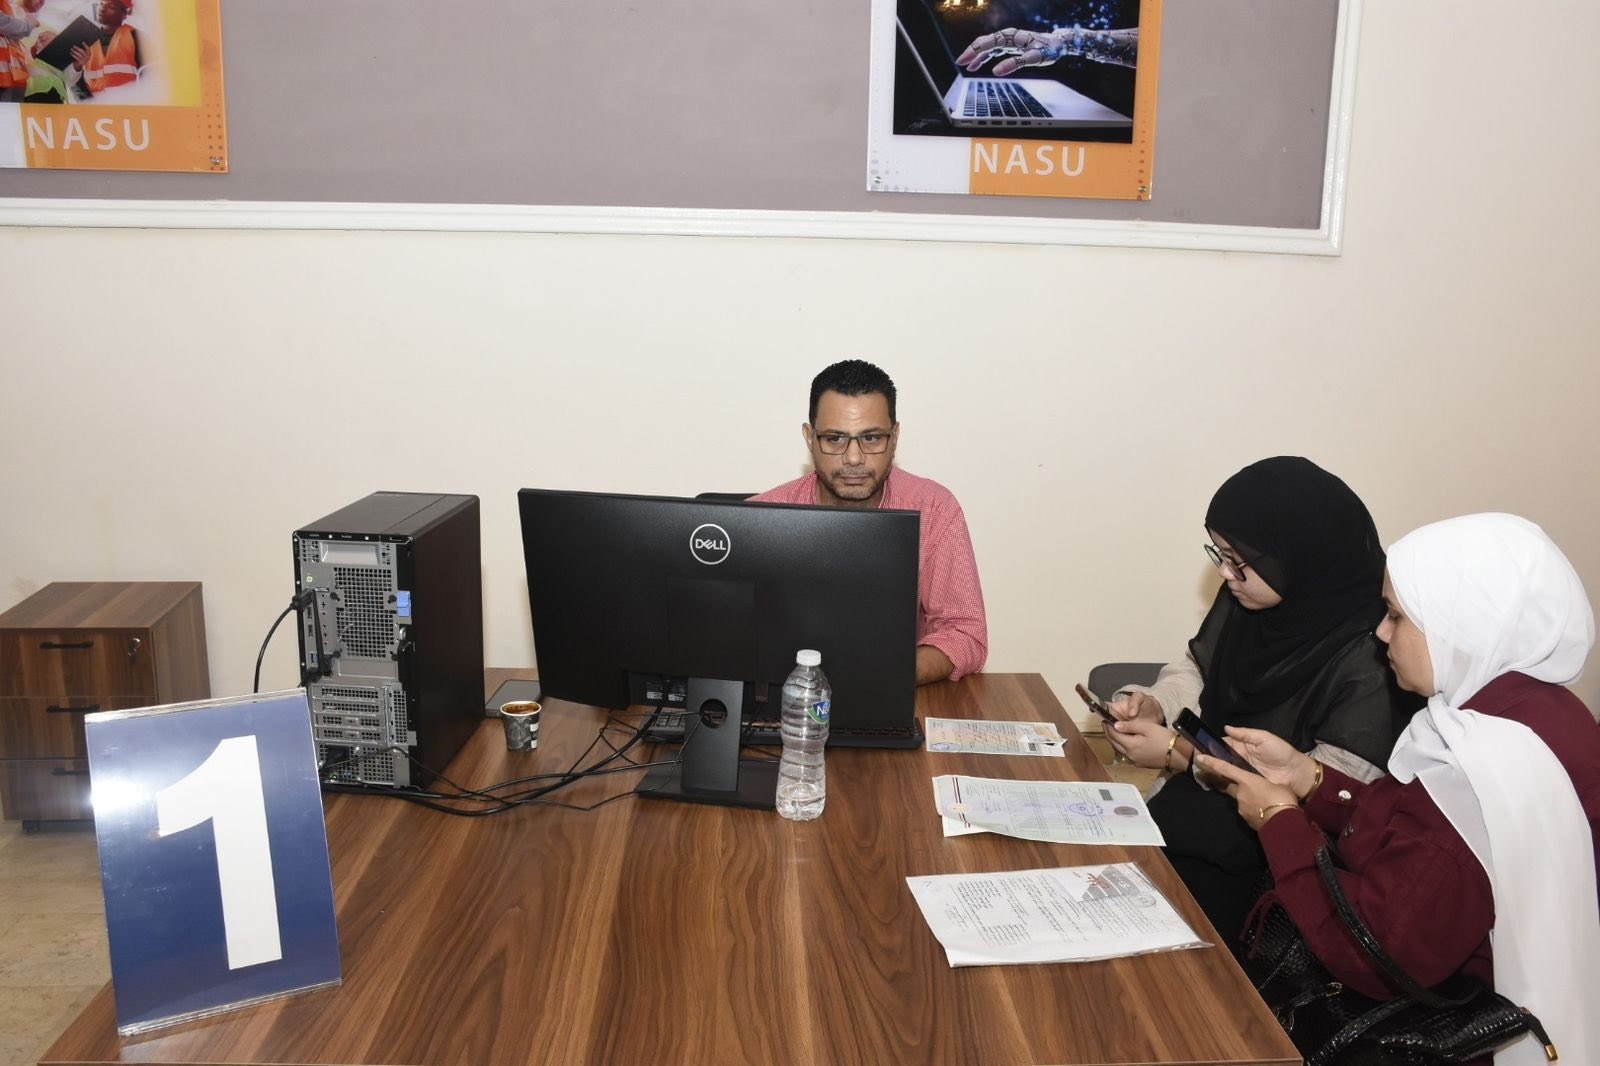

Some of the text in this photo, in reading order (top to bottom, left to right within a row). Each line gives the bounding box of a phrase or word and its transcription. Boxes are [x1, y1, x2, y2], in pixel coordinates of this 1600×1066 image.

[27, 117, 150, 150] NASU
[973, 143, 1086, 177] NASU
[695, 538, 727, 551] DELL
[157, 735, 282, 970] 1
